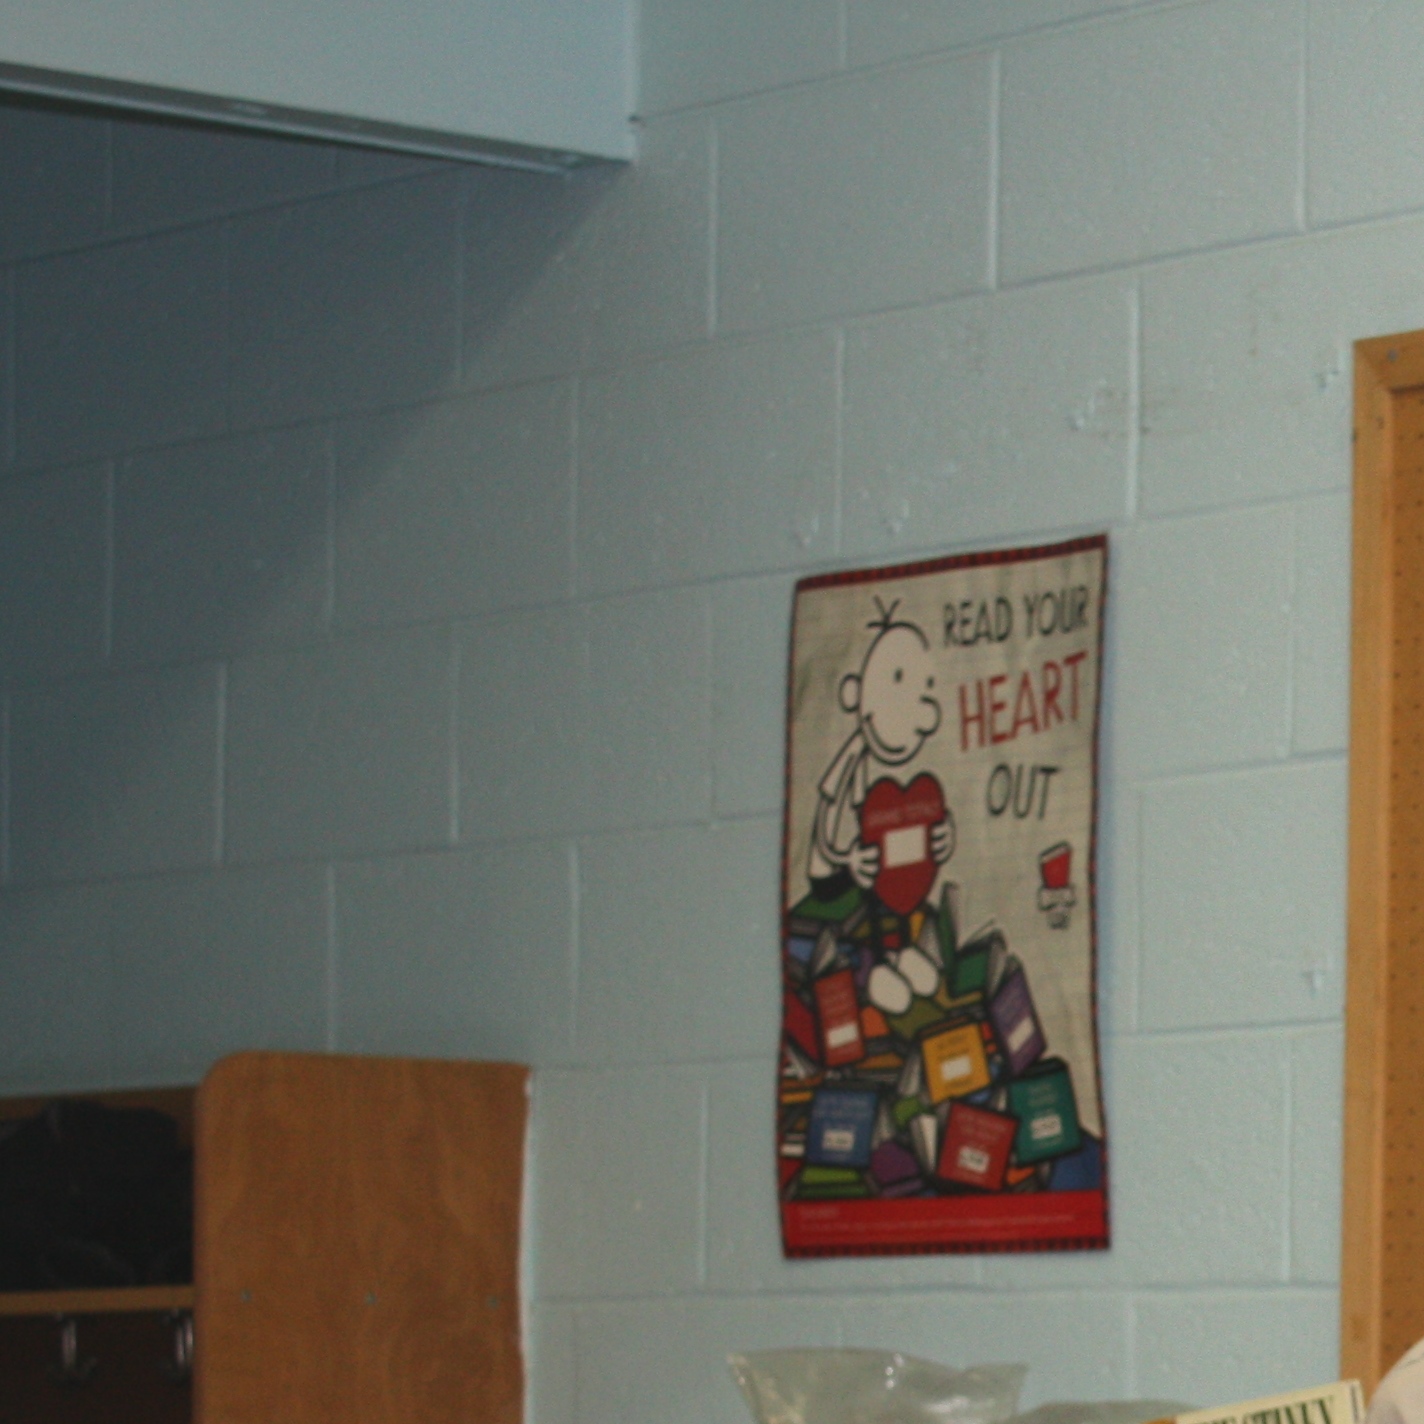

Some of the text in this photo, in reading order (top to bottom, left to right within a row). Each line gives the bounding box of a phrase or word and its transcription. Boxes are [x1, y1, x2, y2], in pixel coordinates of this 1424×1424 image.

[942, 583, 1090, 648] READ YOUR
[957, 650, 1089, 754] HEART
[985, 762, 1061, 820] OUT
